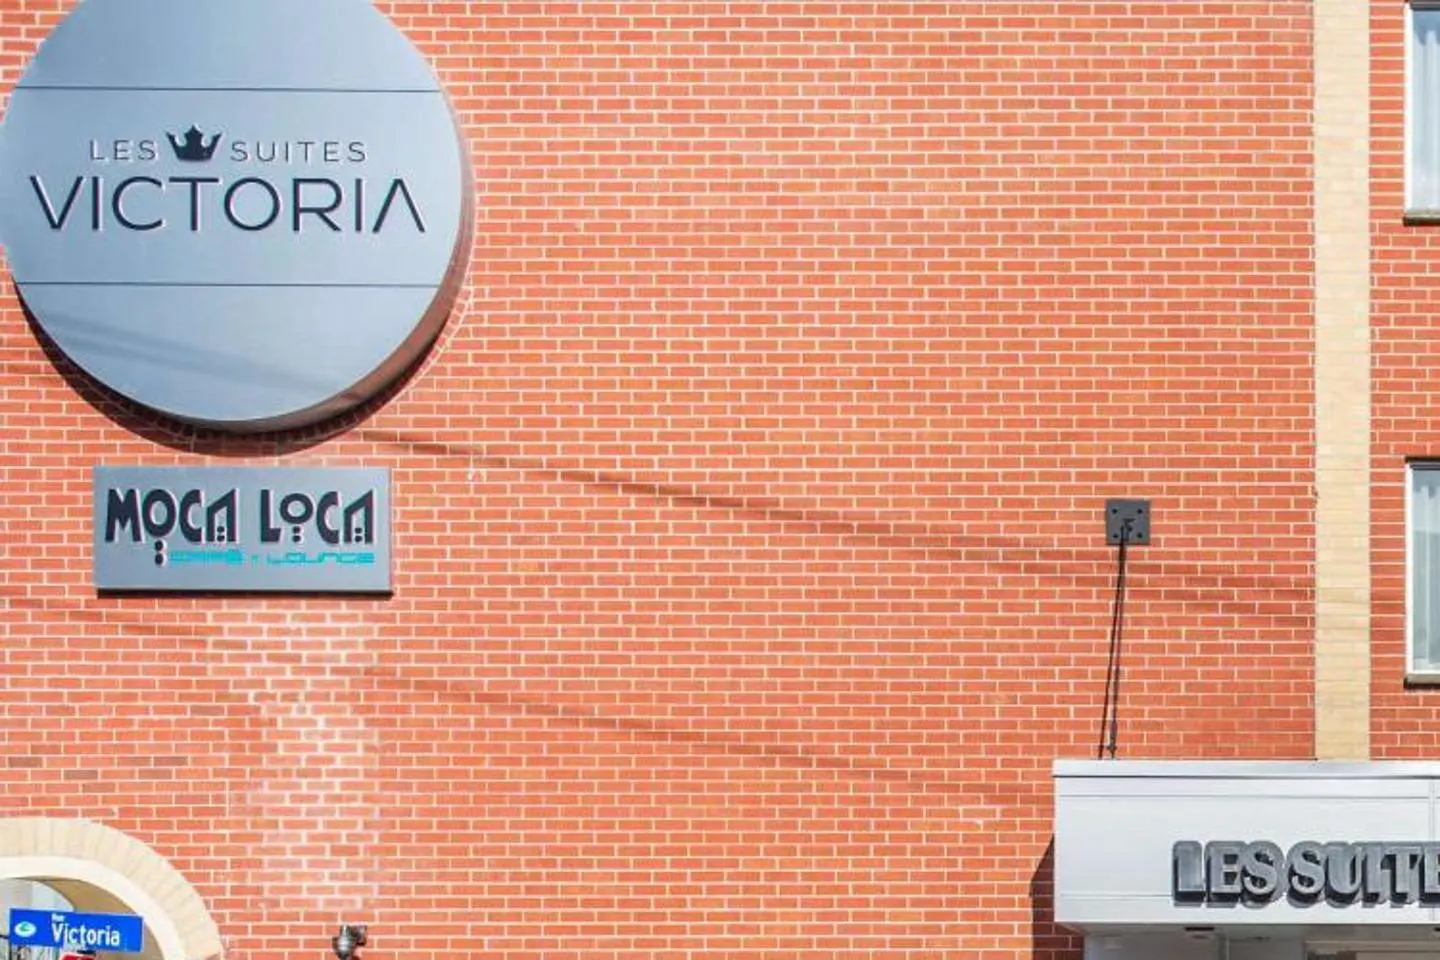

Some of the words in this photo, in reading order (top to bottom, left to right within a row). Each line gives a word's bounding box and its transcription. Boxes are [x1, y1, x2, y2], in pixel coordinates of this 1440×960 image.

[89, 139, 156, 162] LES
[230, 140, 366, 163] SUITES
[29, 175, 427, 233] VICTORIA
[52, 922, 121, 946] Victoria
